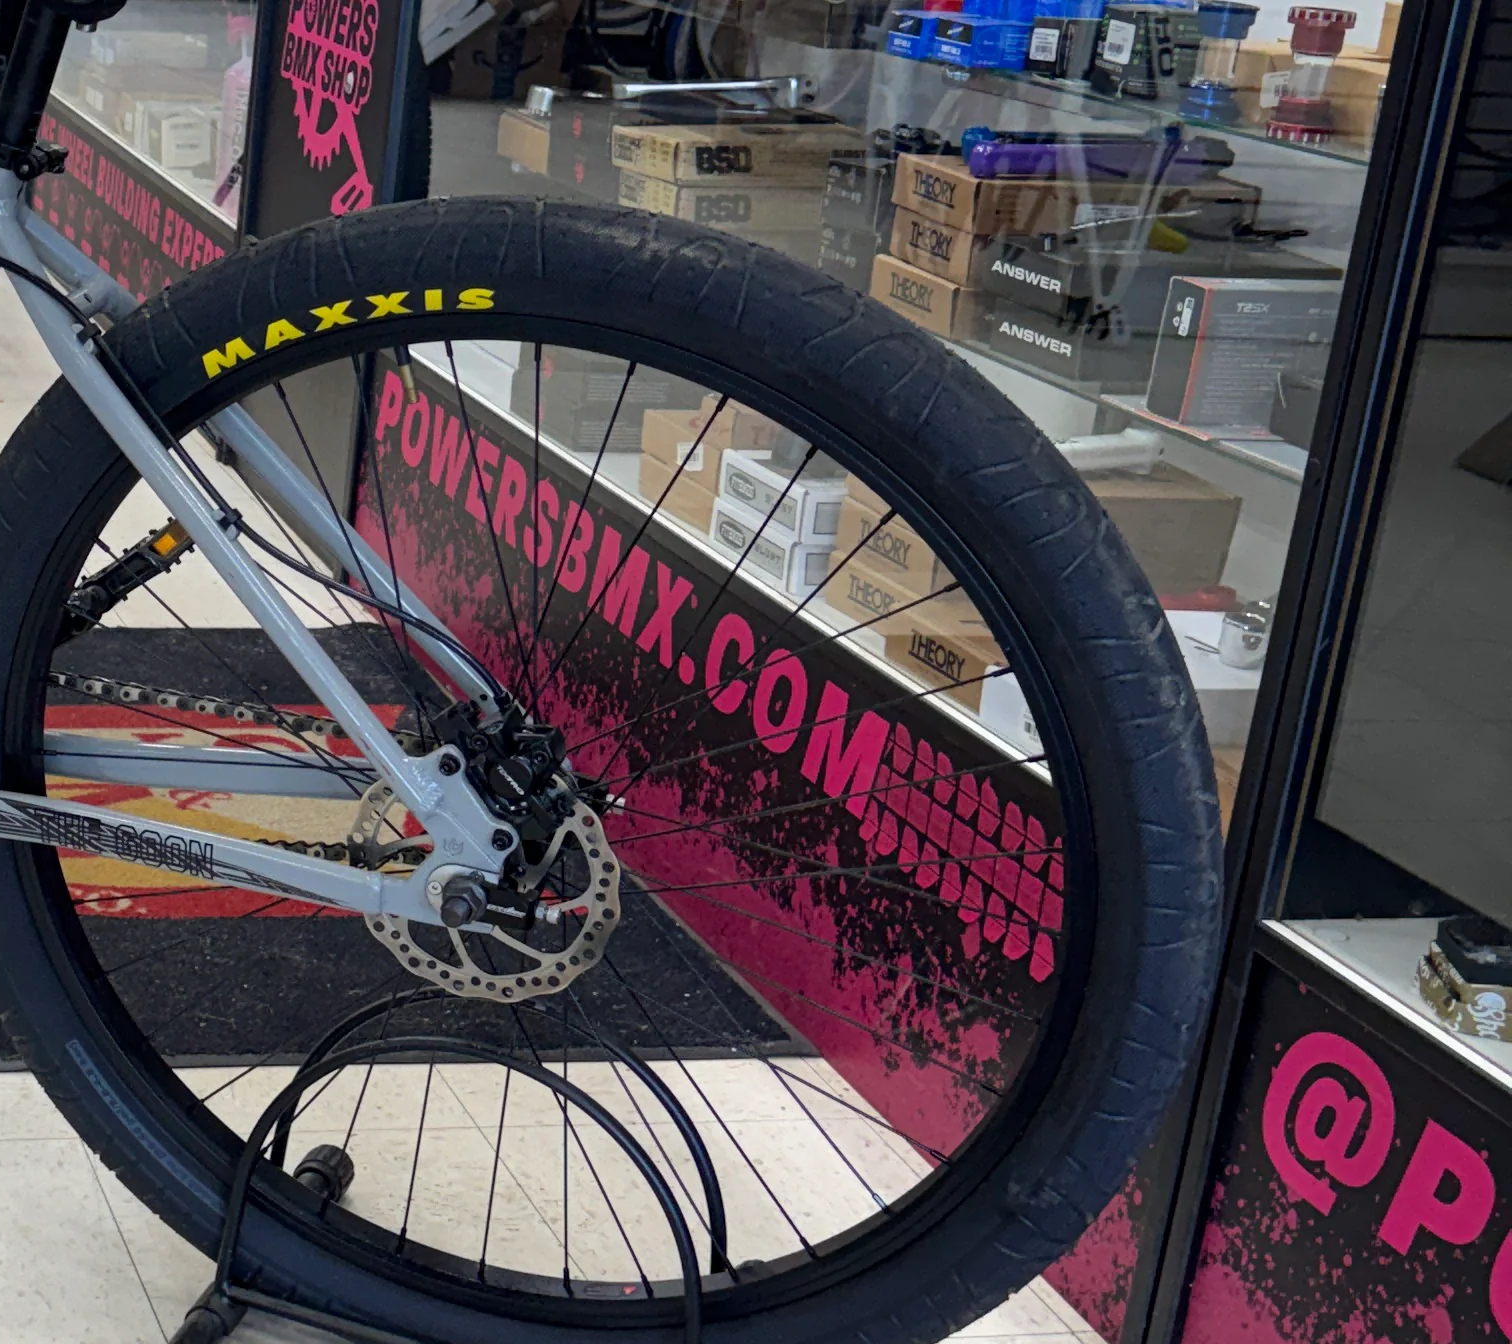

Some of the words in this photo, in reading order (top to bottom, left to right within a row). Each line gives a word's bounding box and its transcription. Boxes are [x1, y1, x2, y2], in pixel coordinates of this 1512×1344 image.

[281, 31, 322, 88] BMX
[321, 49, 372, 110] SHOP
[695, 145, 753, 175] BSD
[95, 153, 162, 245] BUILDING
[694, 194, 752, 223] BSD
[913, 169, 957, 205] THEORY
[910, 220, 953, 257] THEORY
[890, 271, 935, 309] THEORY
[991, 259, 1062, 294] ANSWER
[201, 287, 496, 380] MAXXIS
[998, 321, 1073, 358] ANSWER
[859, 517, 911, 567] THEORY
[374, 368, 891, 823] POWERSBMX.COM
[909, 629, 967, 682] THEORY
[33, 806, 104, 853] THE
[116, 823, 215, 880] GOON
[1262, 1031, 1512, 1344] @P
